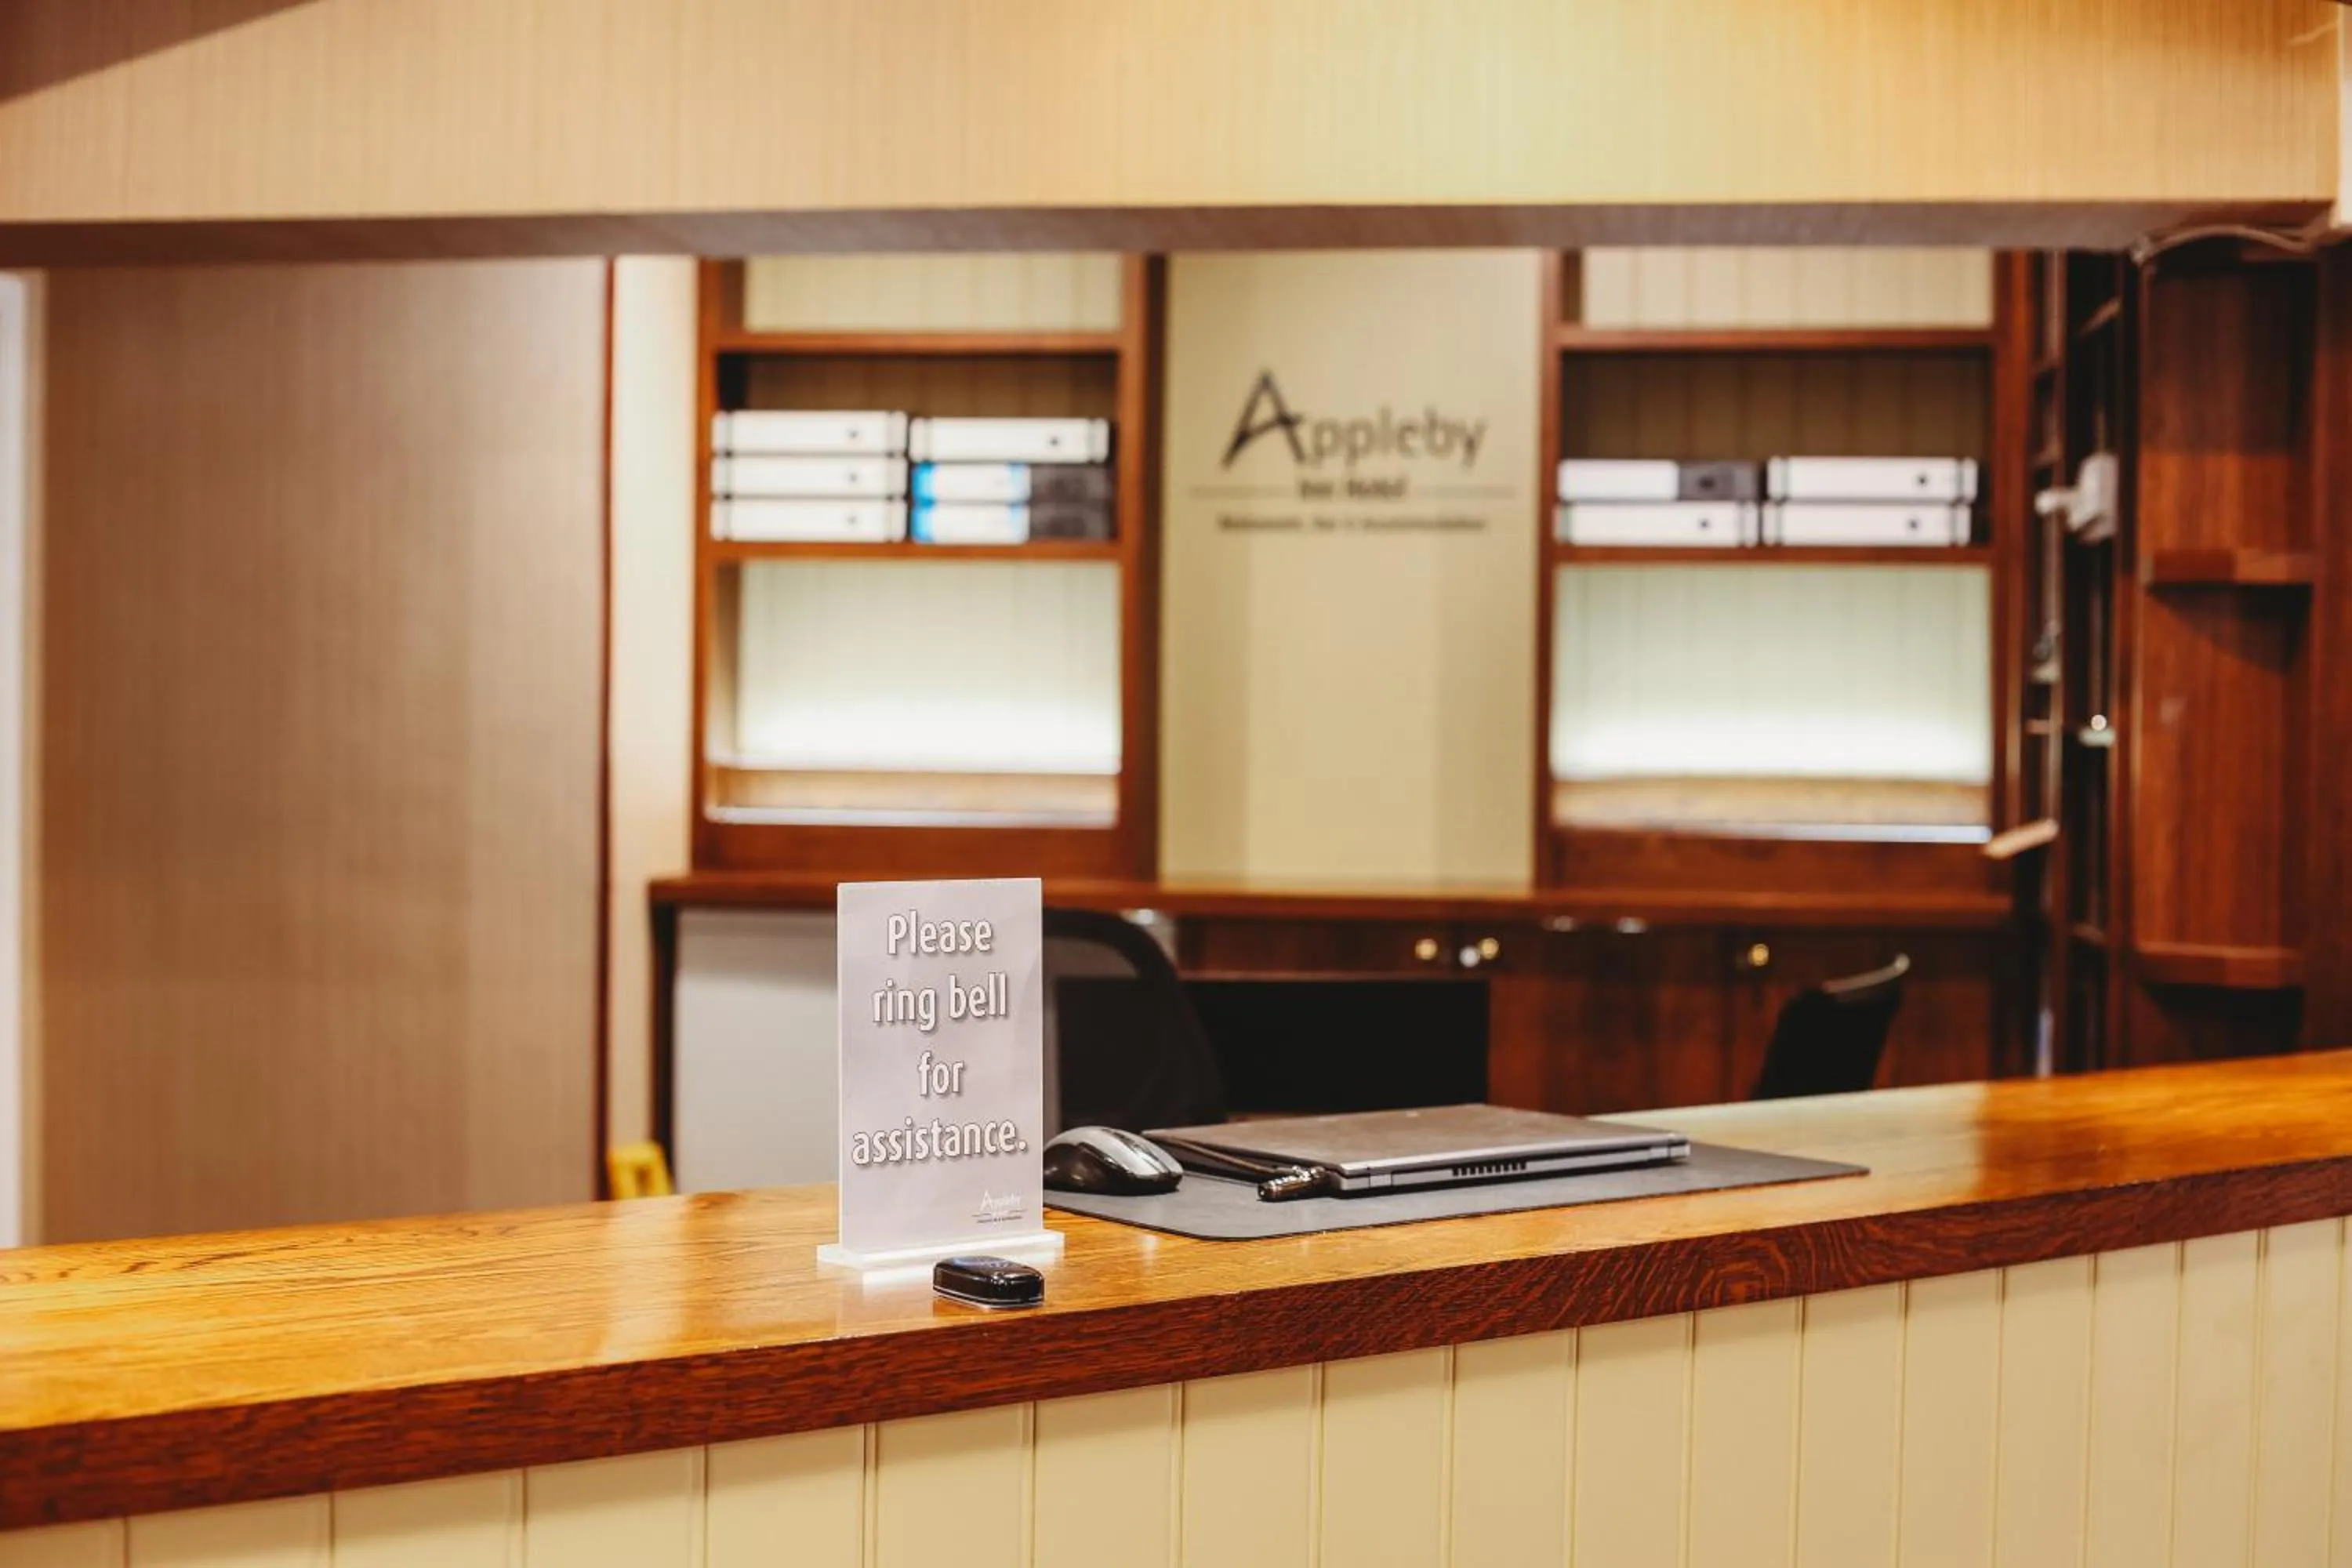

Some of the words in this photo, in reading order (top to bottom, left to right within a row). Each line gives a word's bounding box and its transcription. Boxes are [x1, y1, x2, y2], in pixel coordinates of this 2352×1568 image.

[1220, 370, 1488, 472] Appleby
[887, 909, 993, 956] Please
[872, 978, 938, 1033] ring
[949, 972, 1007, 1019] bell
[917, 1050, 964, 1097] for
[852, 1116, 1029, 1166] assistance.
